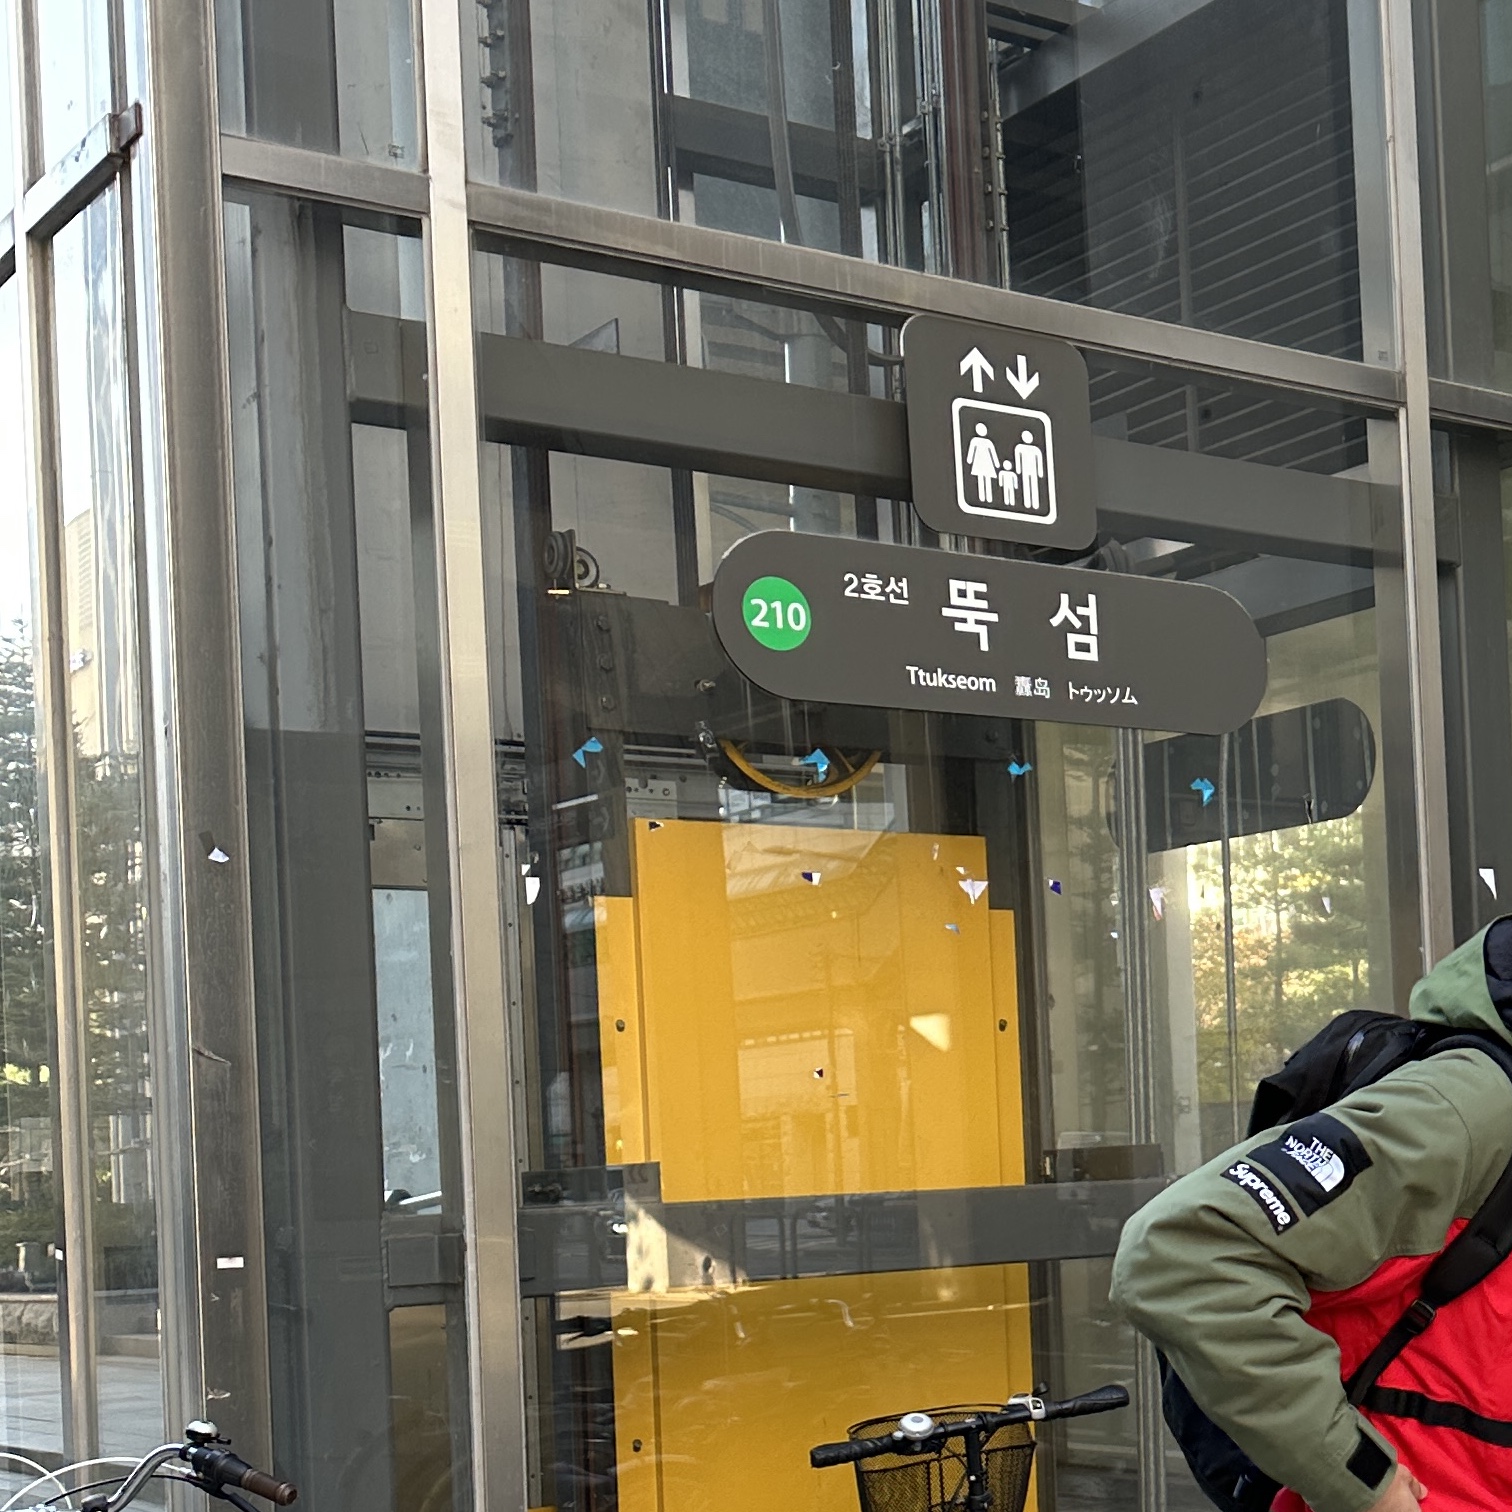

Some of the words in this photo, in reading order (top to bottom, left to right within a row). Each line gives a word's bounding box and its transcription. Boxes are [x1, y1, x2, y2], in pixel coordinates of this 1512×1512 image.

[844, 573, 909, 605] 2호선
[750, 598, 806, 631] 210
[906, 665, 997, 692] Ttukseom
[1285, 1135, 1327, 1168] NORTH
[1310, 1136, 1334, 1161] THE
[1229, 1163, 1291, 1226] Supreme
